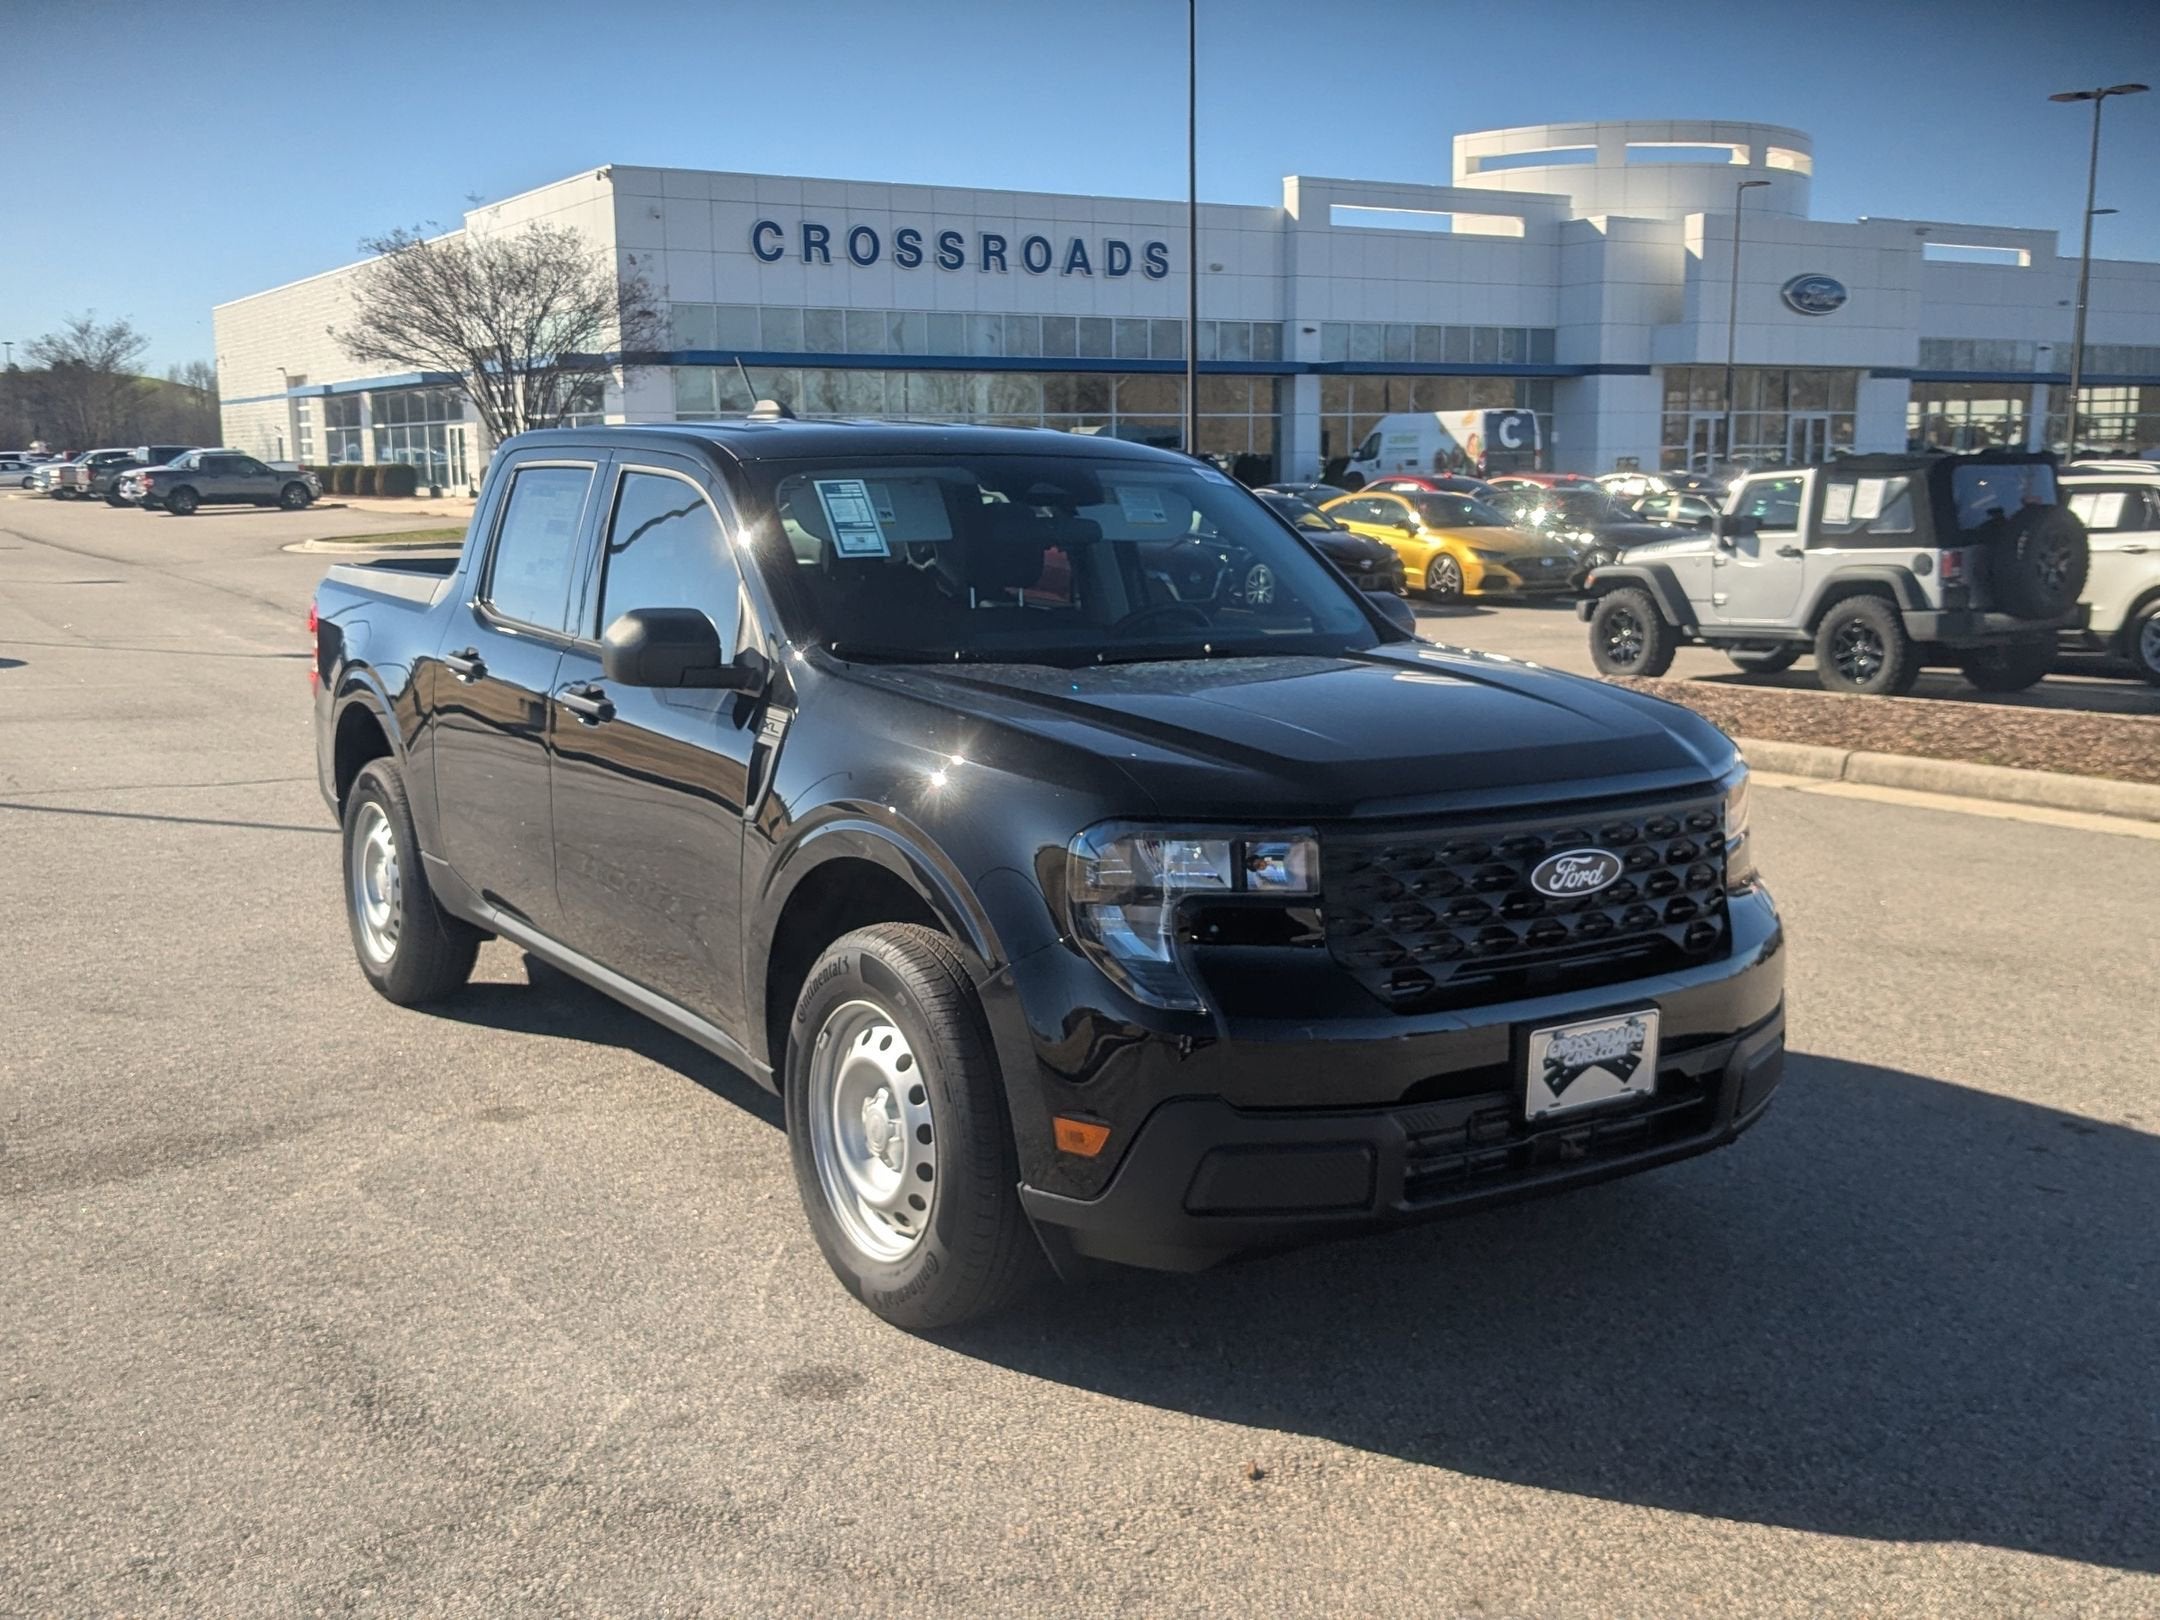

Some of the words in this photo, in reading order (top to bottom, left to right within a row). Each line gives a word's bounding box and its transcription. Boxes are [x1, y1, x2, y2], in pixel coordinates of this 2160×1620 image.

[751, 219, 1170, 279] CROSSROADS
[1498, 416, 1522, 449] C
[1549, 856, 1606, 890] Ford
